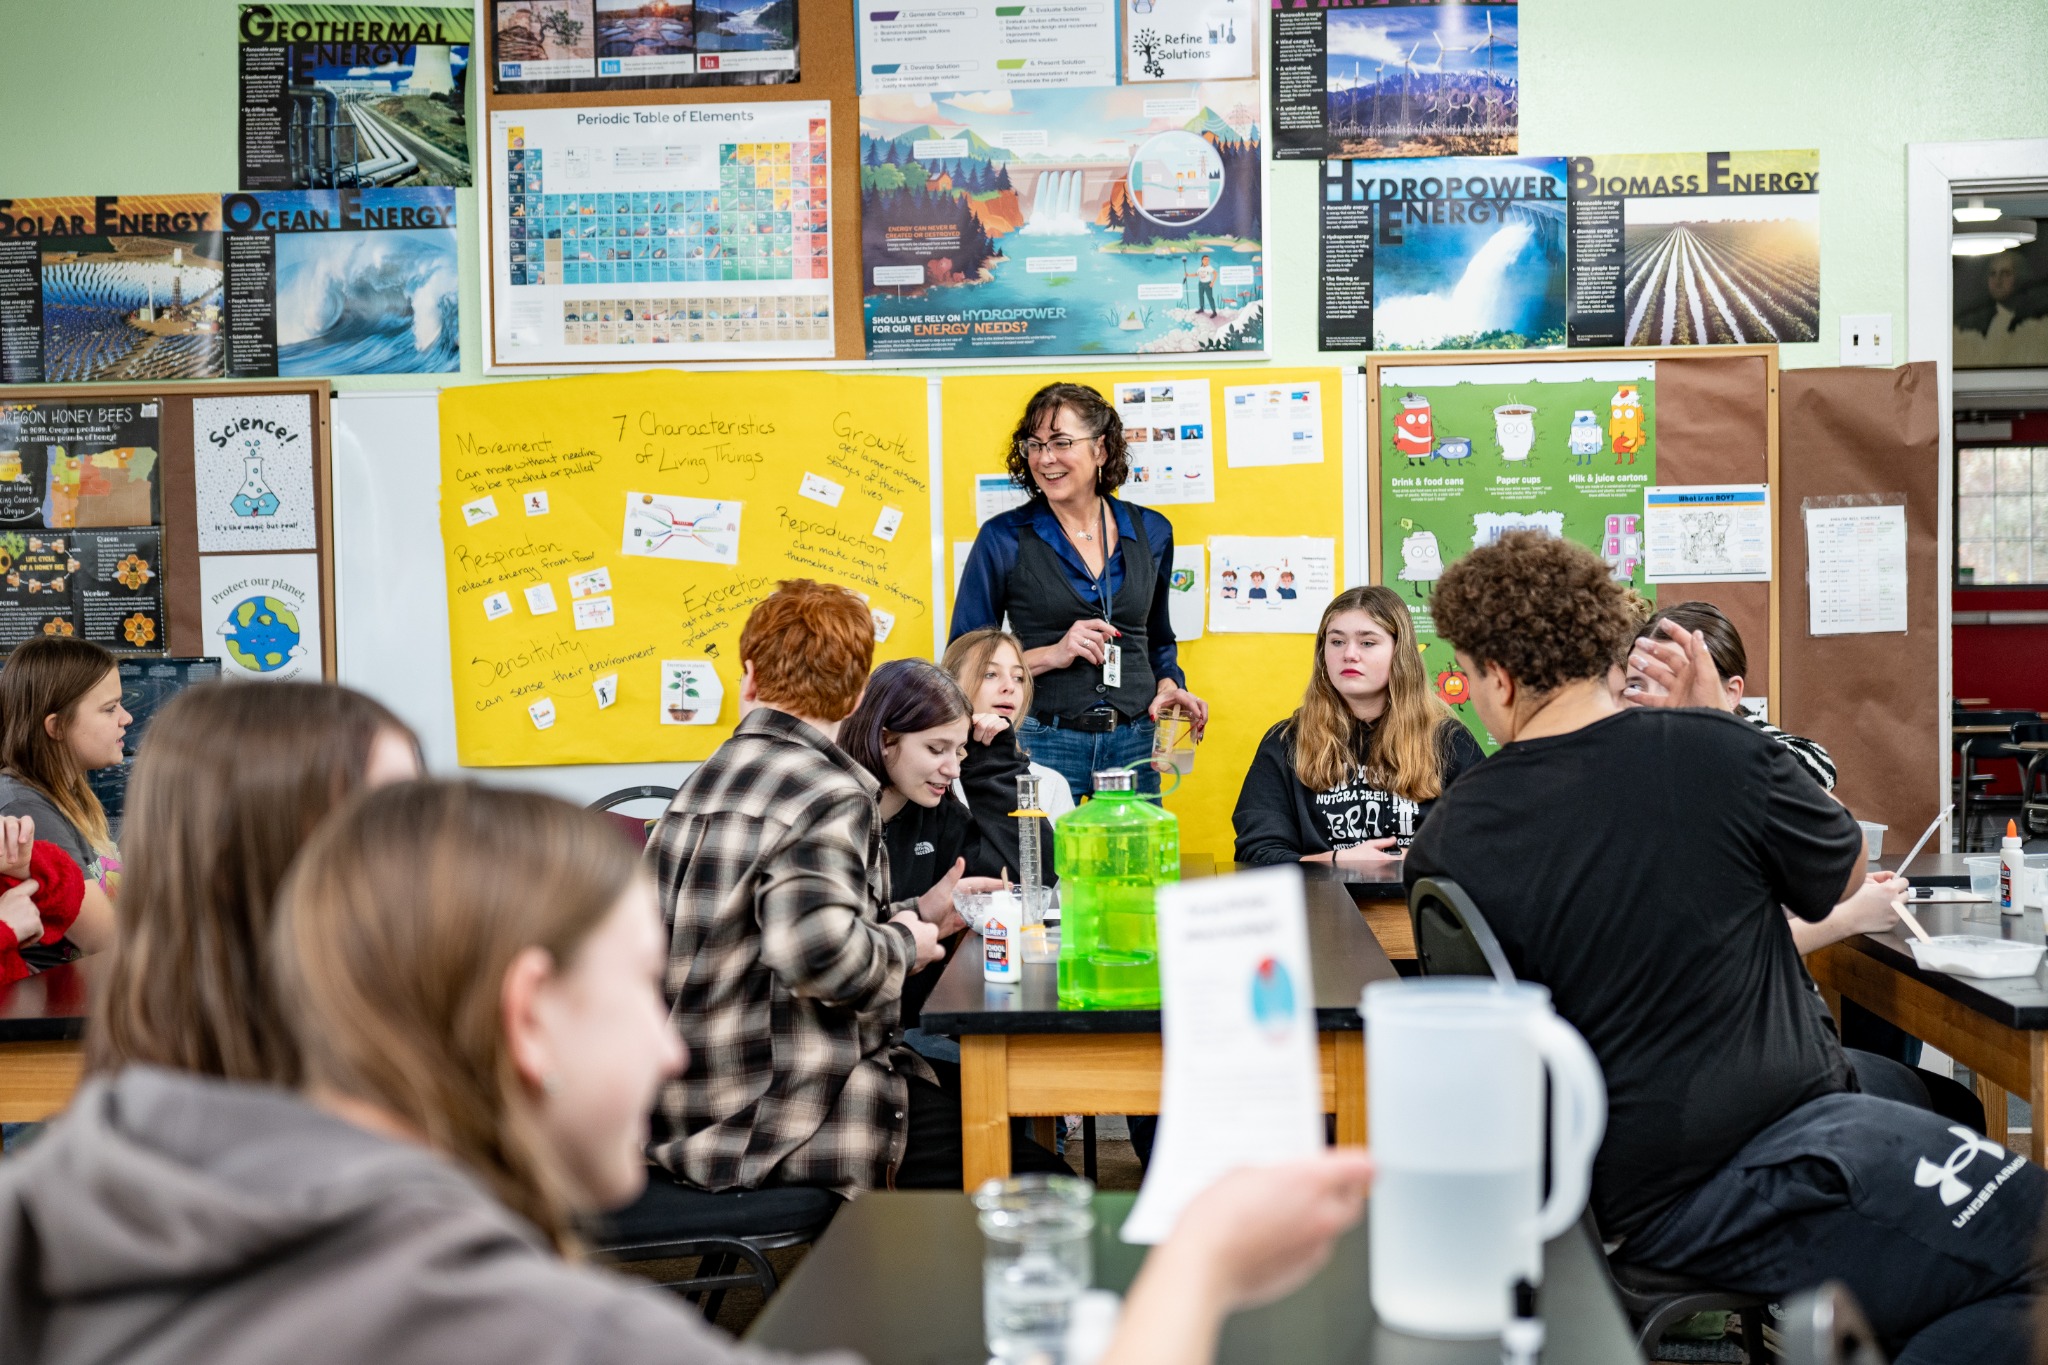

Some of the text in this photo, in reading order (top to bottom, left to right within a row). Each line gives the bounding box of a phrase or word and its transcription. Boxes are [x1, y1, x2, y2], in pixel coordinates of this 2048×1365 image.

[240, 7, 447, 41] GEOTHERMAL
[938, 10, 965, 18] Concepts
[1158, 48, 1211, 60] Solutions
[1165, 34, 1203, 45] Refine
[292, 44, 412, 85] ENERGY
[502, 64, 522, 78] Plants
[577, 110, 754, 125] Periodic Table of Elements
[1319, 160, 1556, 200] HYDROPOWER
[1573, 151, 1819, 196] BIOMASS ENERGY
[96, 196, 208, 235] ENERGY
[223, 189, 452, 231] OCEAN ENERGY
[1379, 201, 1513, 245] ENERGY
[872, 308, 1067, 324] SHOULD WE RELY ON HYDROPOWER
[872, 322, 1028, 336] FOR OUR ENERGY NEEDS?
[52, 408, 93, 424] HONEY
[98, 408, 133, 423] BEES
[612, 411, 775, 442] 7 Characteristics
[31, 434, 56, 442] million
[58, 434, 84, 443] pounds
[94, 433, 117, 442] honey!
[49, 427, 75, 435] Oregon
[76, 426, 111, 436] produced
[210, 418, 299, 448] Science!
[486, 463, 513, 476] move
[515, 454, 557, 470] without
[563, 447, 602, 464] needing
[635, 443, 764, 484] of Living Things
[839, 443, 857, 462] get
[861, 449, 892, 477] larger
[14, 484, 33, 495] Honey
[470, 461, 596, 494] to be pushed or pulled
[864, 469, 876, 483] of
[879, 477, 904, 496] their
[1392, 477, 1464, 486] Drink & food cans
[1496, 476, 1542, 486] Paper cups
[1568, 473, 1648, 484] Milk & juice cartons
[14, 496, 39, 504] Counties
[861, 484, 883, 501] lives
[1678, 495, 1697, 503] What
[1716, 494, 1735, 502] ROV?
[4, 507, 25, 518] Oregon
[244, 524, 264, 532] magic
[266, 522, 279, 530] but
[776, 506, 886, 559] Reproduction
[454, 533, 563, 574] Respiration
[793, 539, 875, 577] can make copy
[456, 550, 596, 594] release energy from food
[784, 550, 926, 619] themselves or create offspring
[211, 578, 307, 605] Protect our planet,
[683, 574, 775, 613] Excretion
[682, 596, 762, 635] get rid of waste
[682, 620, 729, 648] products
[475, 645, 657, 712] can sense their environment
[1326, 801, 1383, 839] ERA
[1952, 1180, 2000, 1229] UNDER
